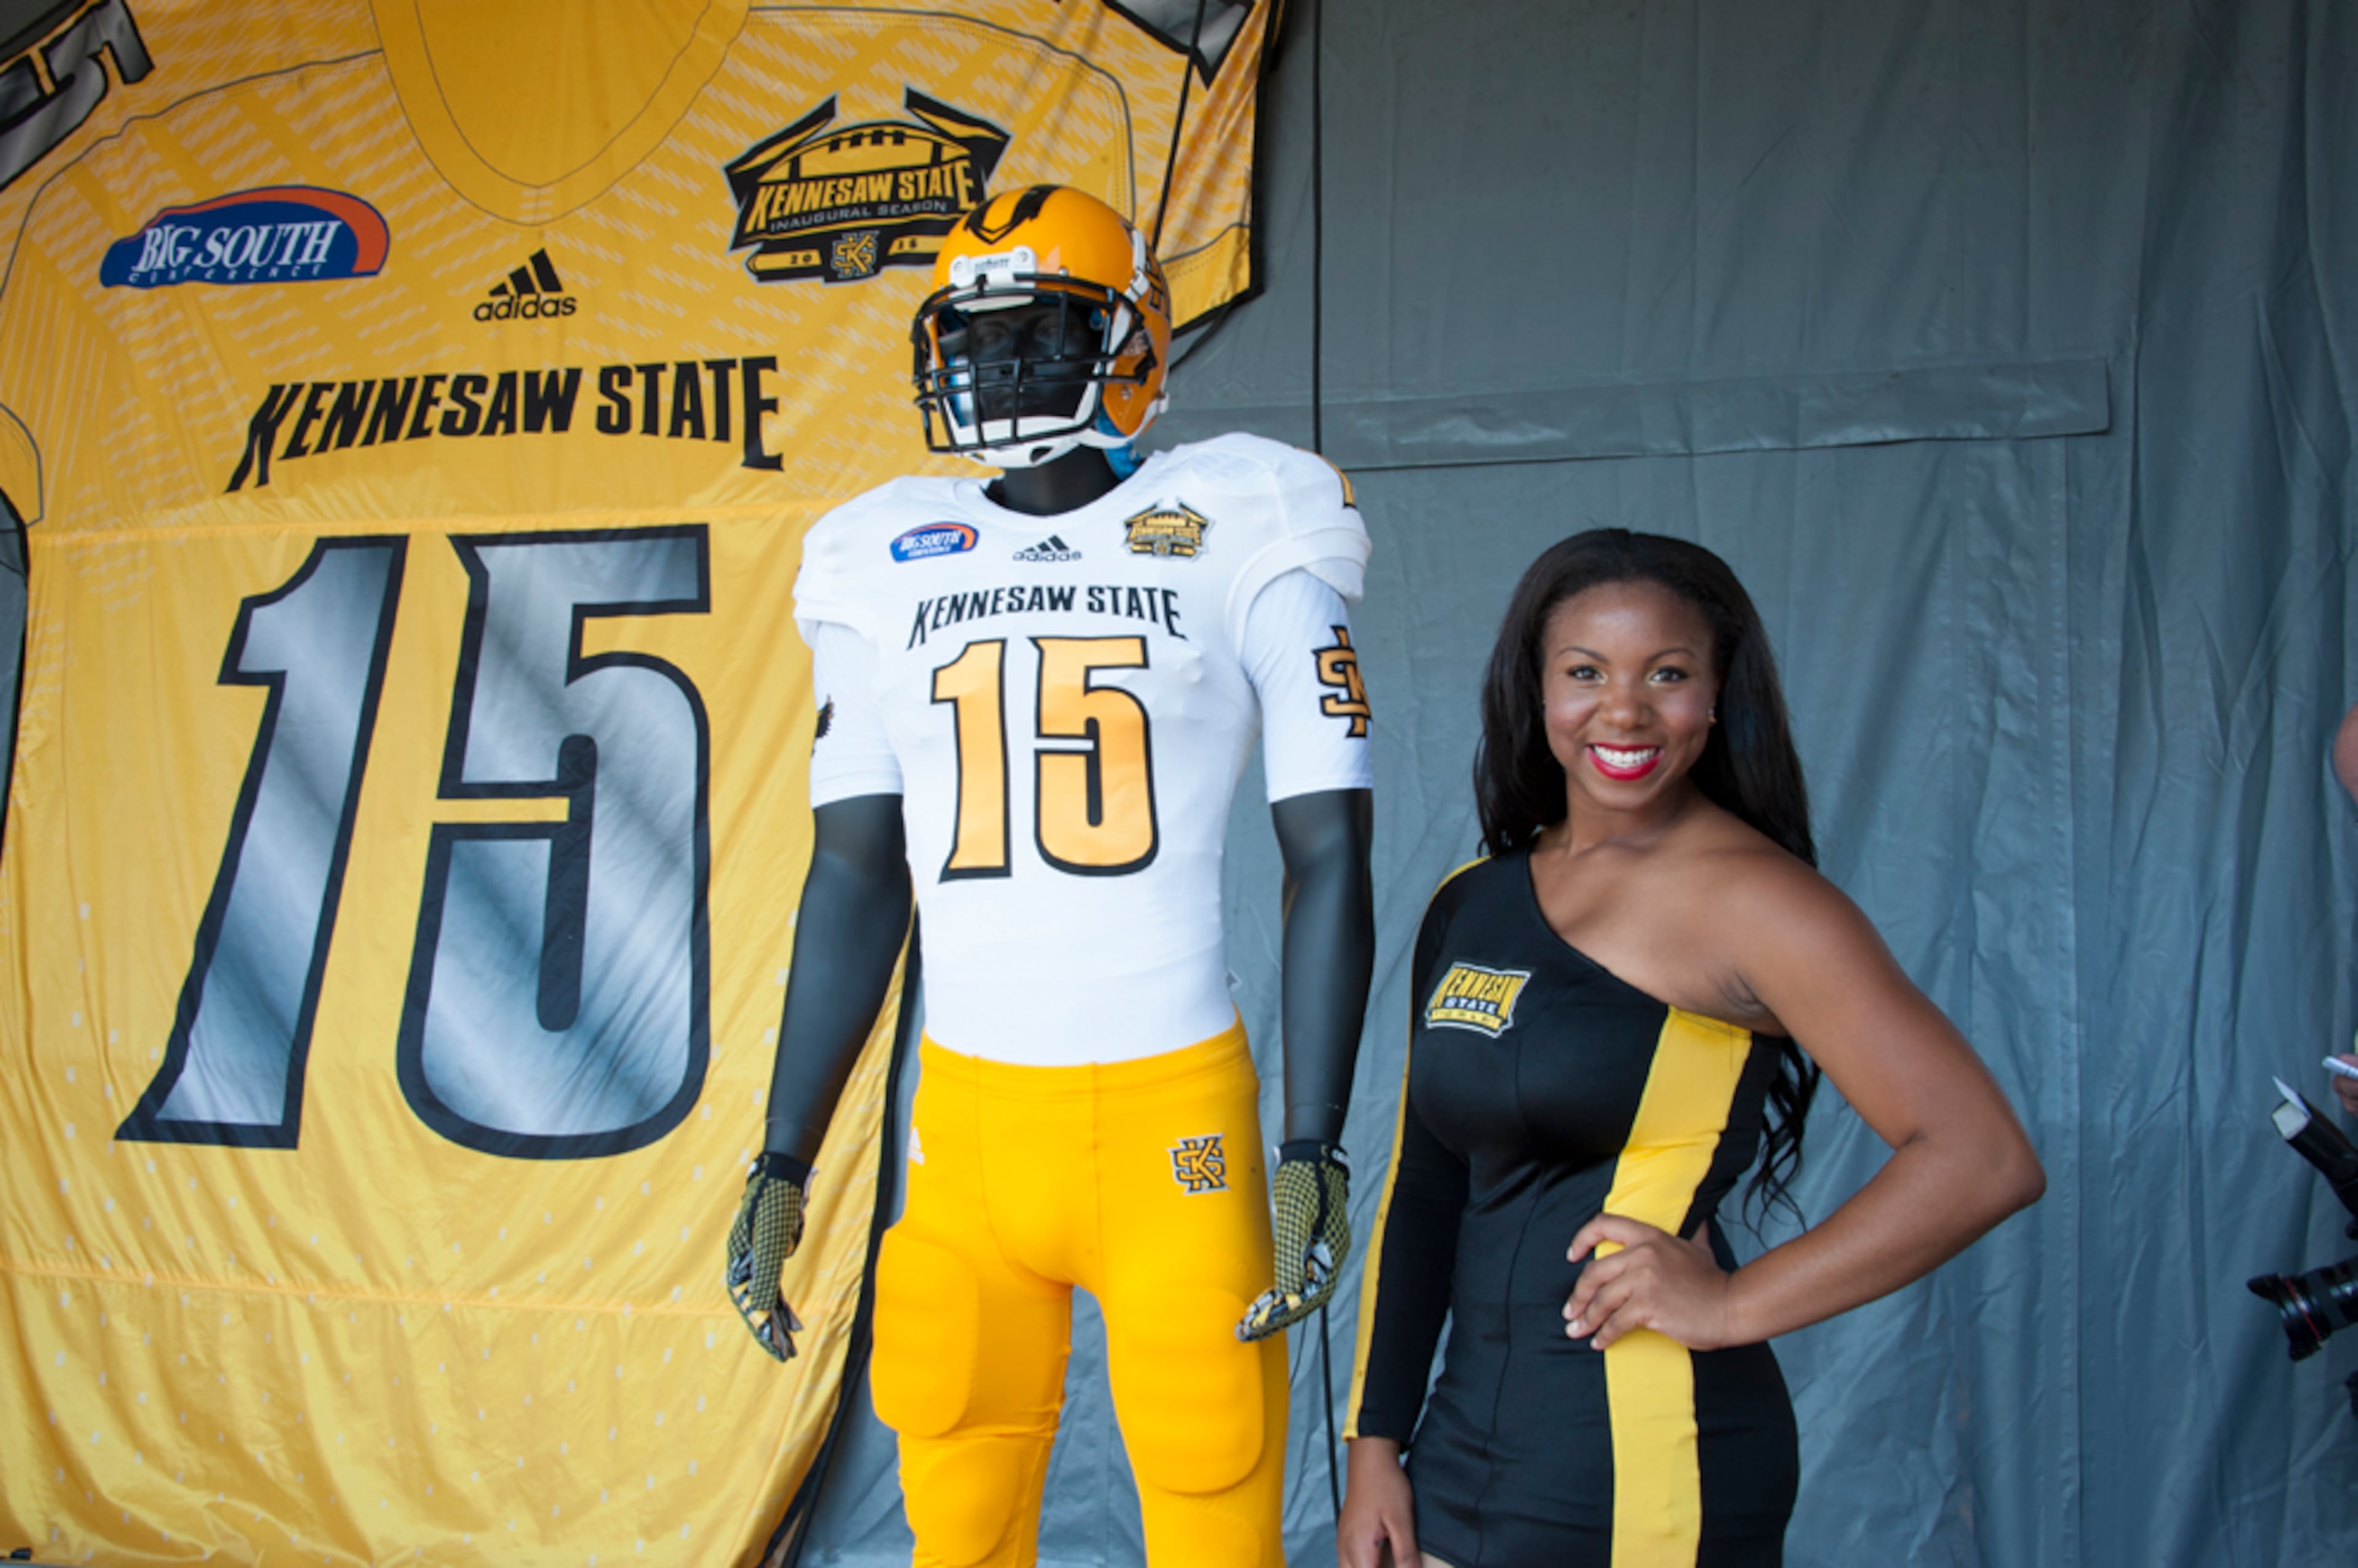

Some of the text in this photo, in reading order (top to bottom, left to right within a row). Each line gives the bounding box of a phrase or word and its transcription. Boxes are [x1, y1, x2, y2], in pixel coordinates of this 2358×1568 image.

[744, 159, 978, 234] KENNESAW STATE
[769, 198, 948, 232] INAUGURAL SEASON
[131, 220, 343, 272] BIG SOUTH
[473, 293, 577, 322] adidas
[223, 356, 784, 494] KENNESAW STATE
[1013, 551, 1082, 562] adidas
[906, 586, 1189, 651] KENNESAW STATE
[930, 635, 1159, 885] 15
[113, 523, 710, 1159] 15
[1444, 997, 1498, 1015] STATE
